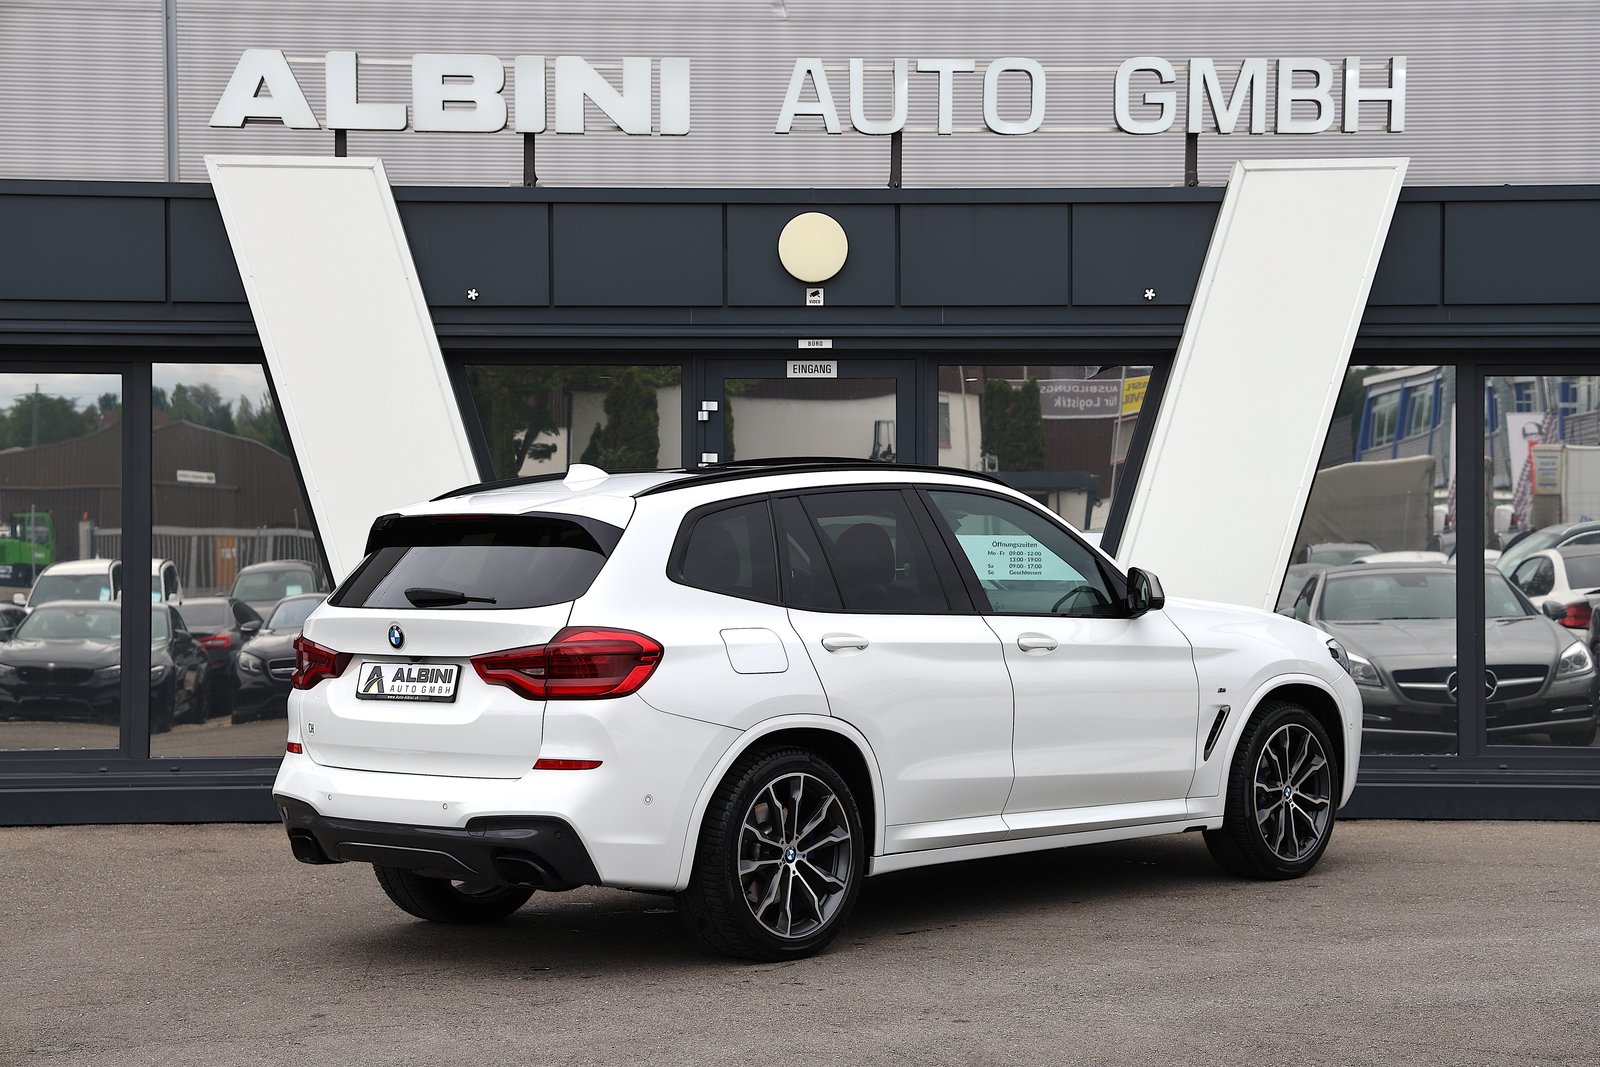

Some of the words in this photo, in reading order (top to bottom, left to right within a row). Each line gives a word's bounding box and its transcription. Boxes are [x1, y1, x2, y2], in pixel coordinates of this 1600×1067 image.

[208, 48, 691, 136] ALBINI
[774, 57, 1047, 136] AUTO
[1114, 56, 1408, 136] GMBH
[792, 364, 832, 374] EINGANG
[391, 667, 454, 684] ALBINI
[389, 684, 417, 693] AUTO
[421, 685, 451, 694] GMBH
[308, 722, 315, 733] CH
